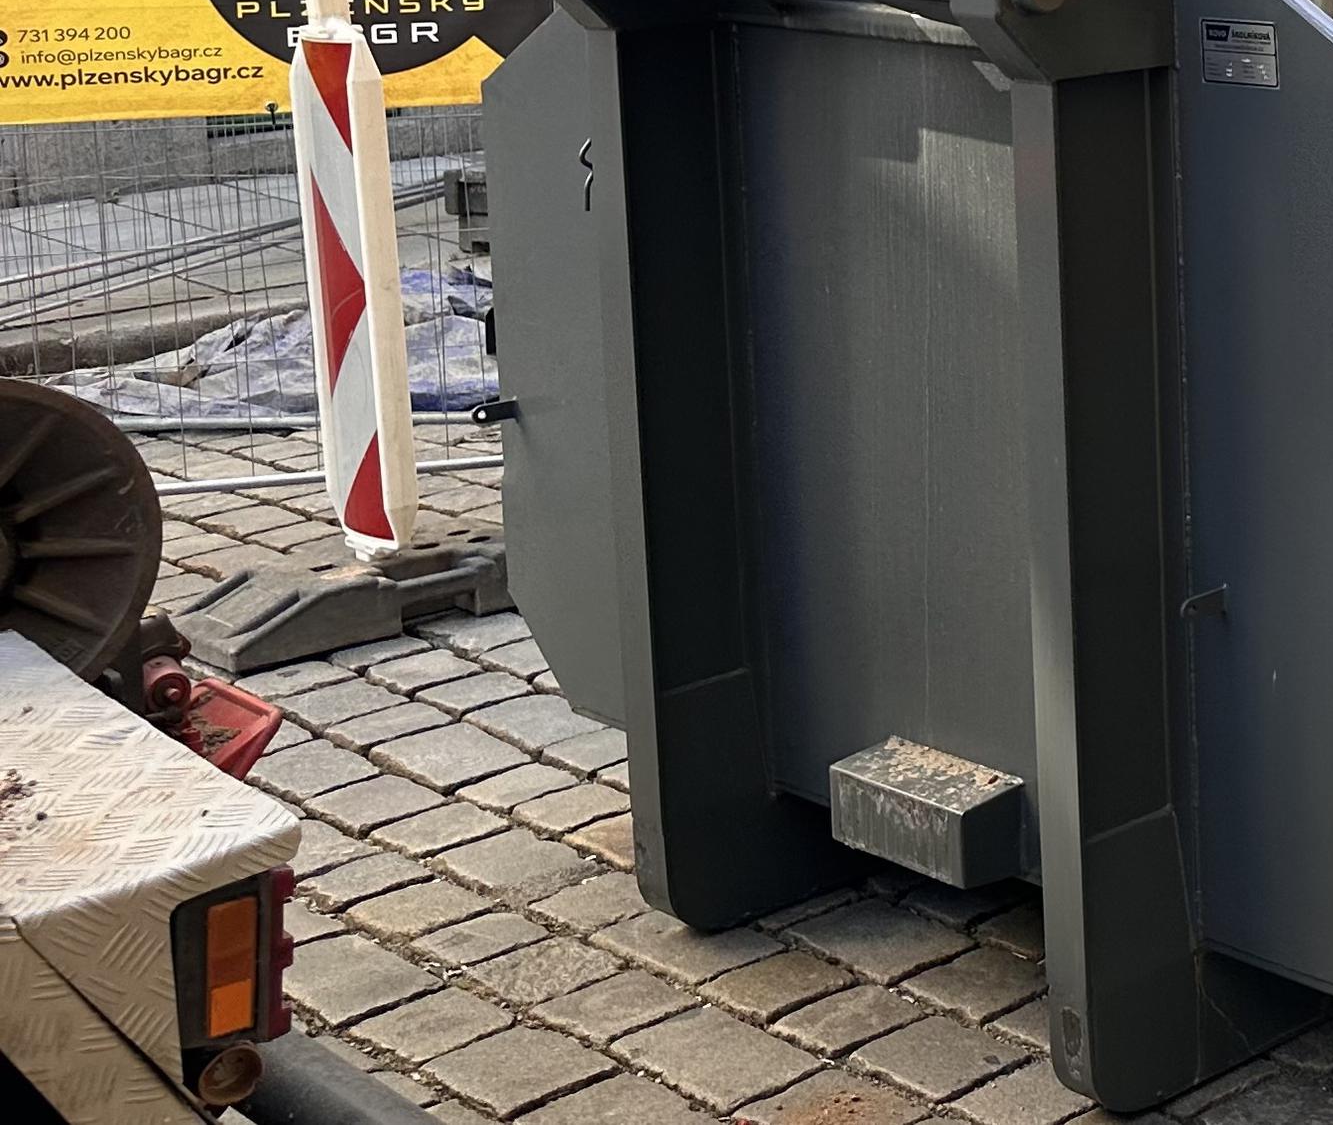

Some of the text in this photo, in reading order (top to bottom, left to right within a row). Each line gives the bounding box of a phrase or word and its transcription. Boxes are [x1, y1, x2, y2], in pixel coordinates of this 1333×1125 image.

[17, 26, 131, 43] 731 394 200
[21, 46, 222, 65] info@plzenskybagr.cz
